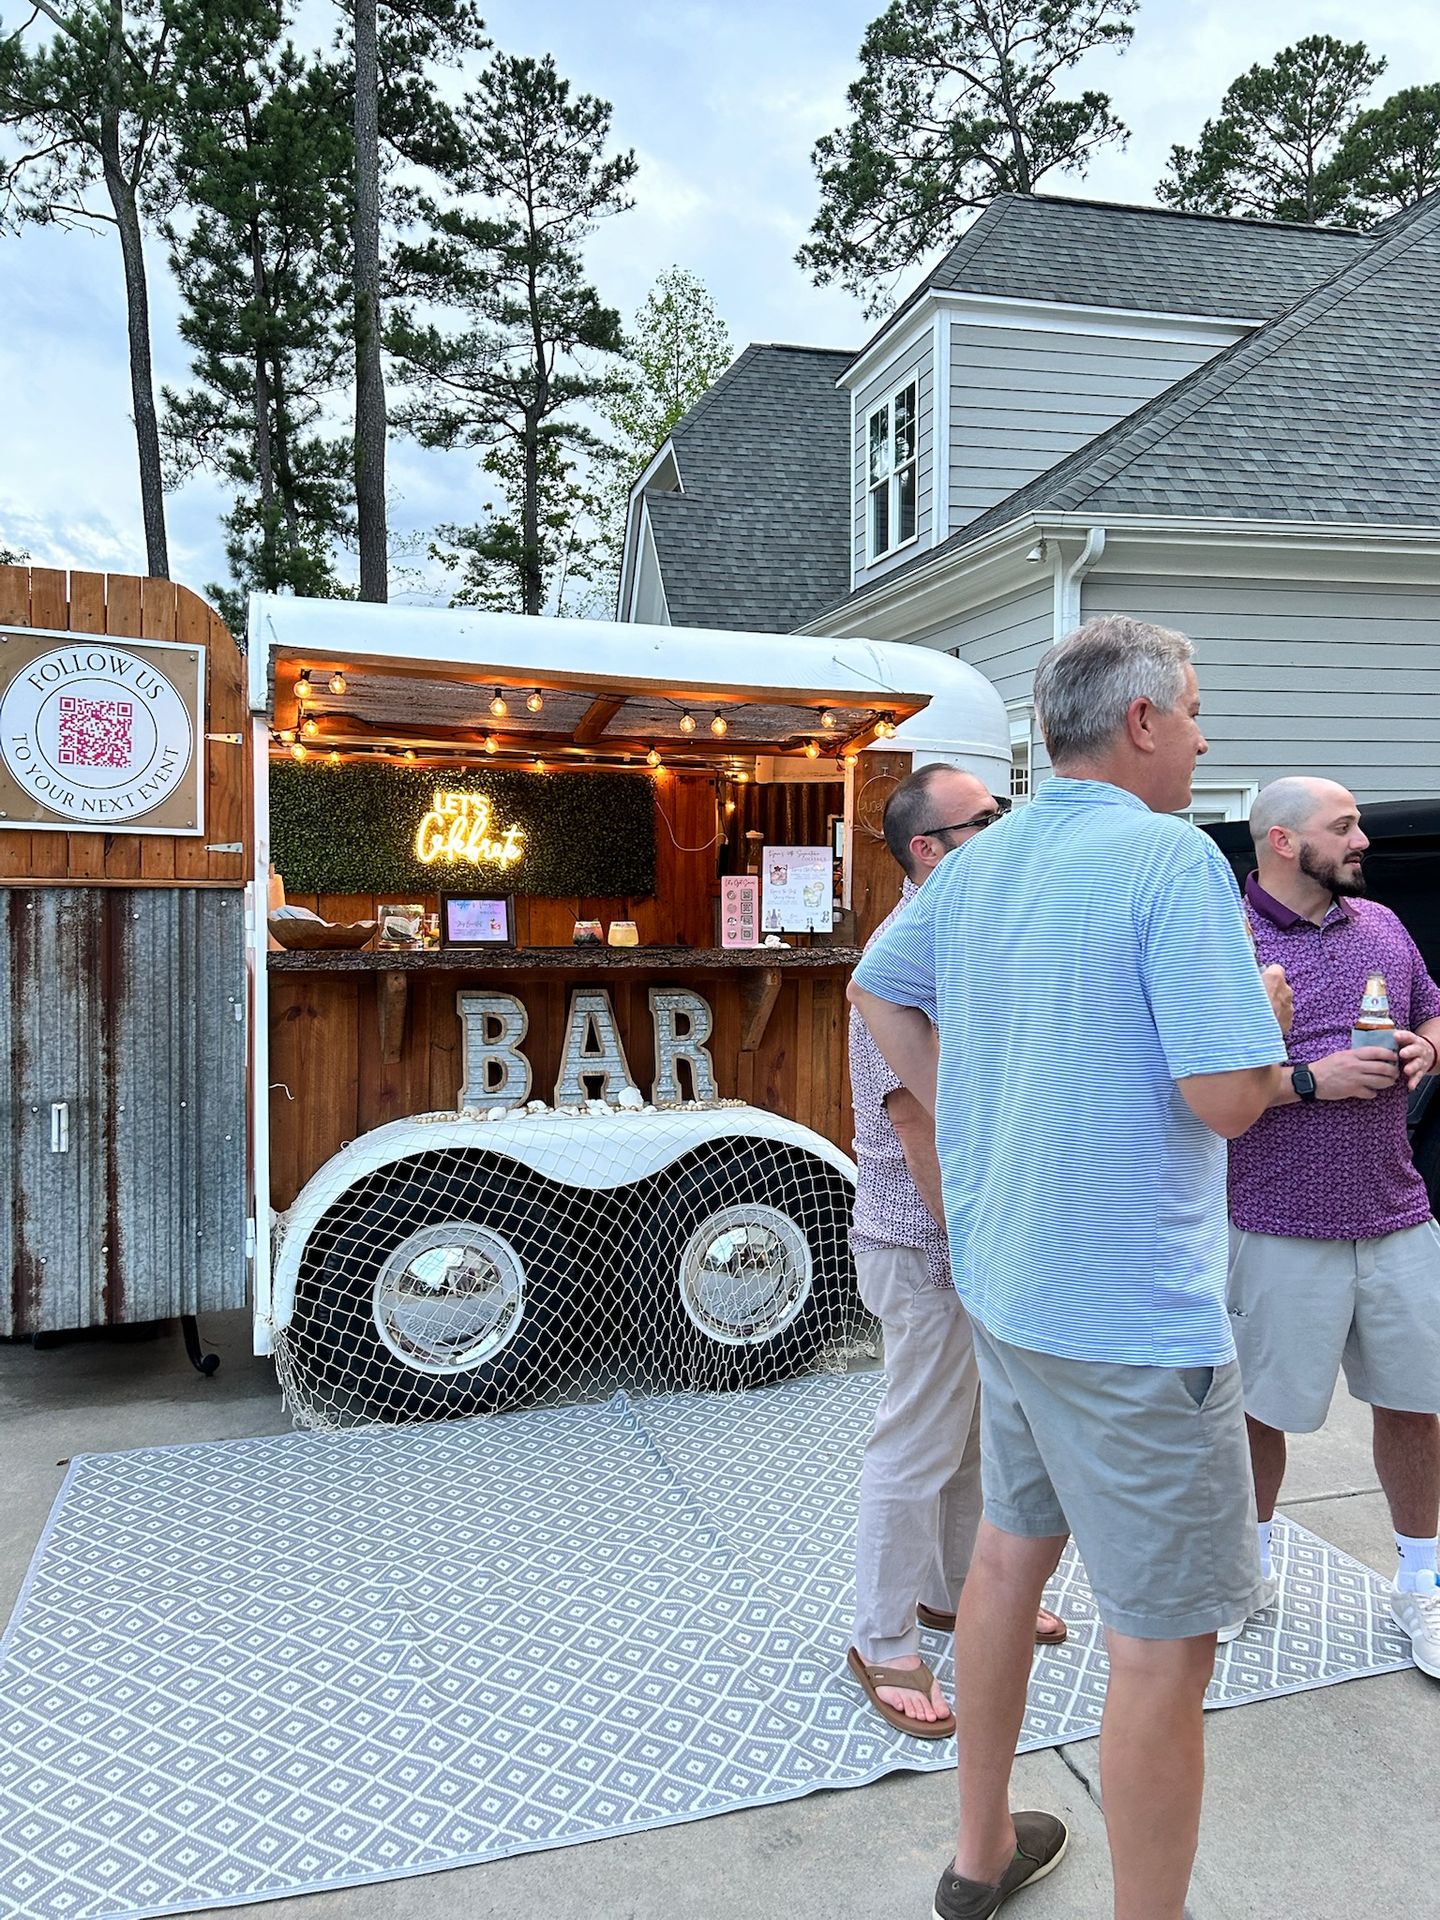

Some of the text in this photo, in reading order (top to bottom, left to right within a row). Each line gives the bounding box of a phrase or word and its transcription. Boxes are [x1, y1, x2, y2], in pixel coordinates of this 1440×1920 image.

[27, 653, 165, 700] FOLLOW US
[11, 732, 179, 813] TO YOUR NEXT EVENT
[458, 988, 718, 1111] BAR
